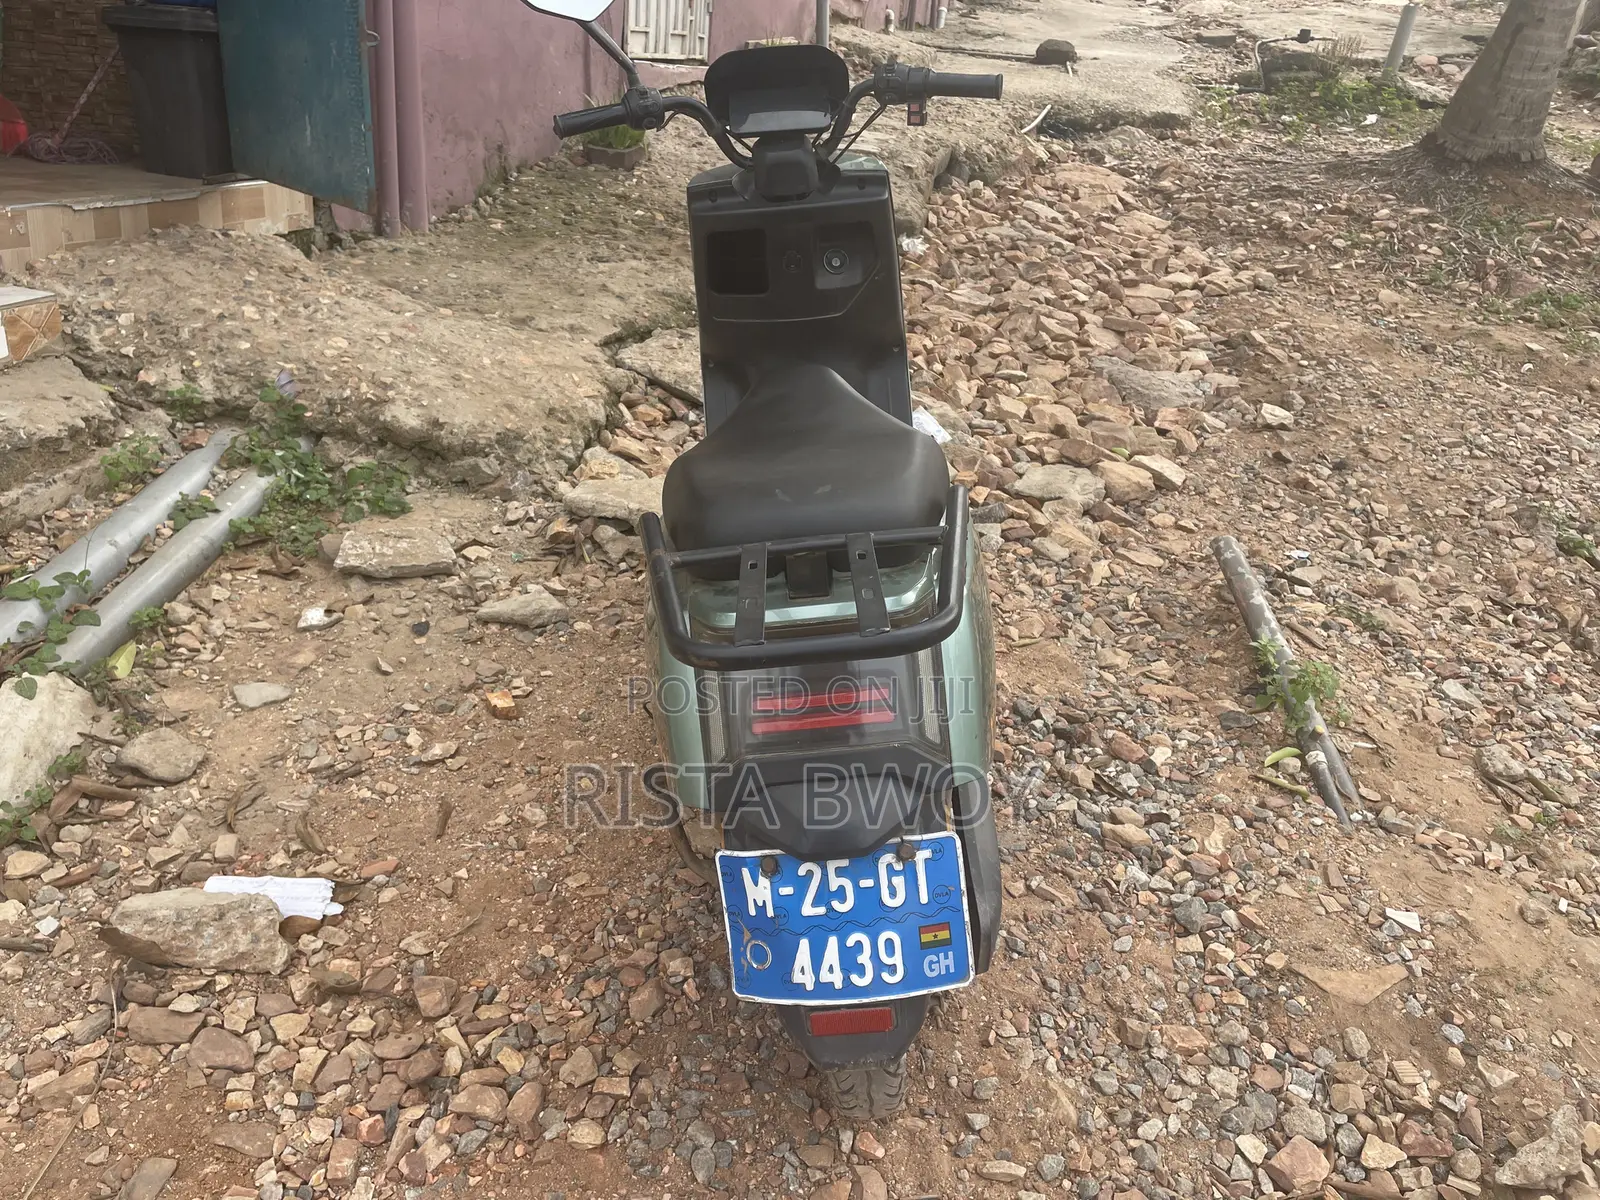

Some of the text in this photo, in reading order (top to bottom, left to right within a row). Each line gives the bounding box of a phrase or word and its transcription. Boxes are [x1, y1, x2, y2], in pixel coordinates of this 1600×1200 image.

[741, 849, 933, 918] M-25-GT
[791, 930, 904, 991] 4439
[923, 951, 955, 978] GH
